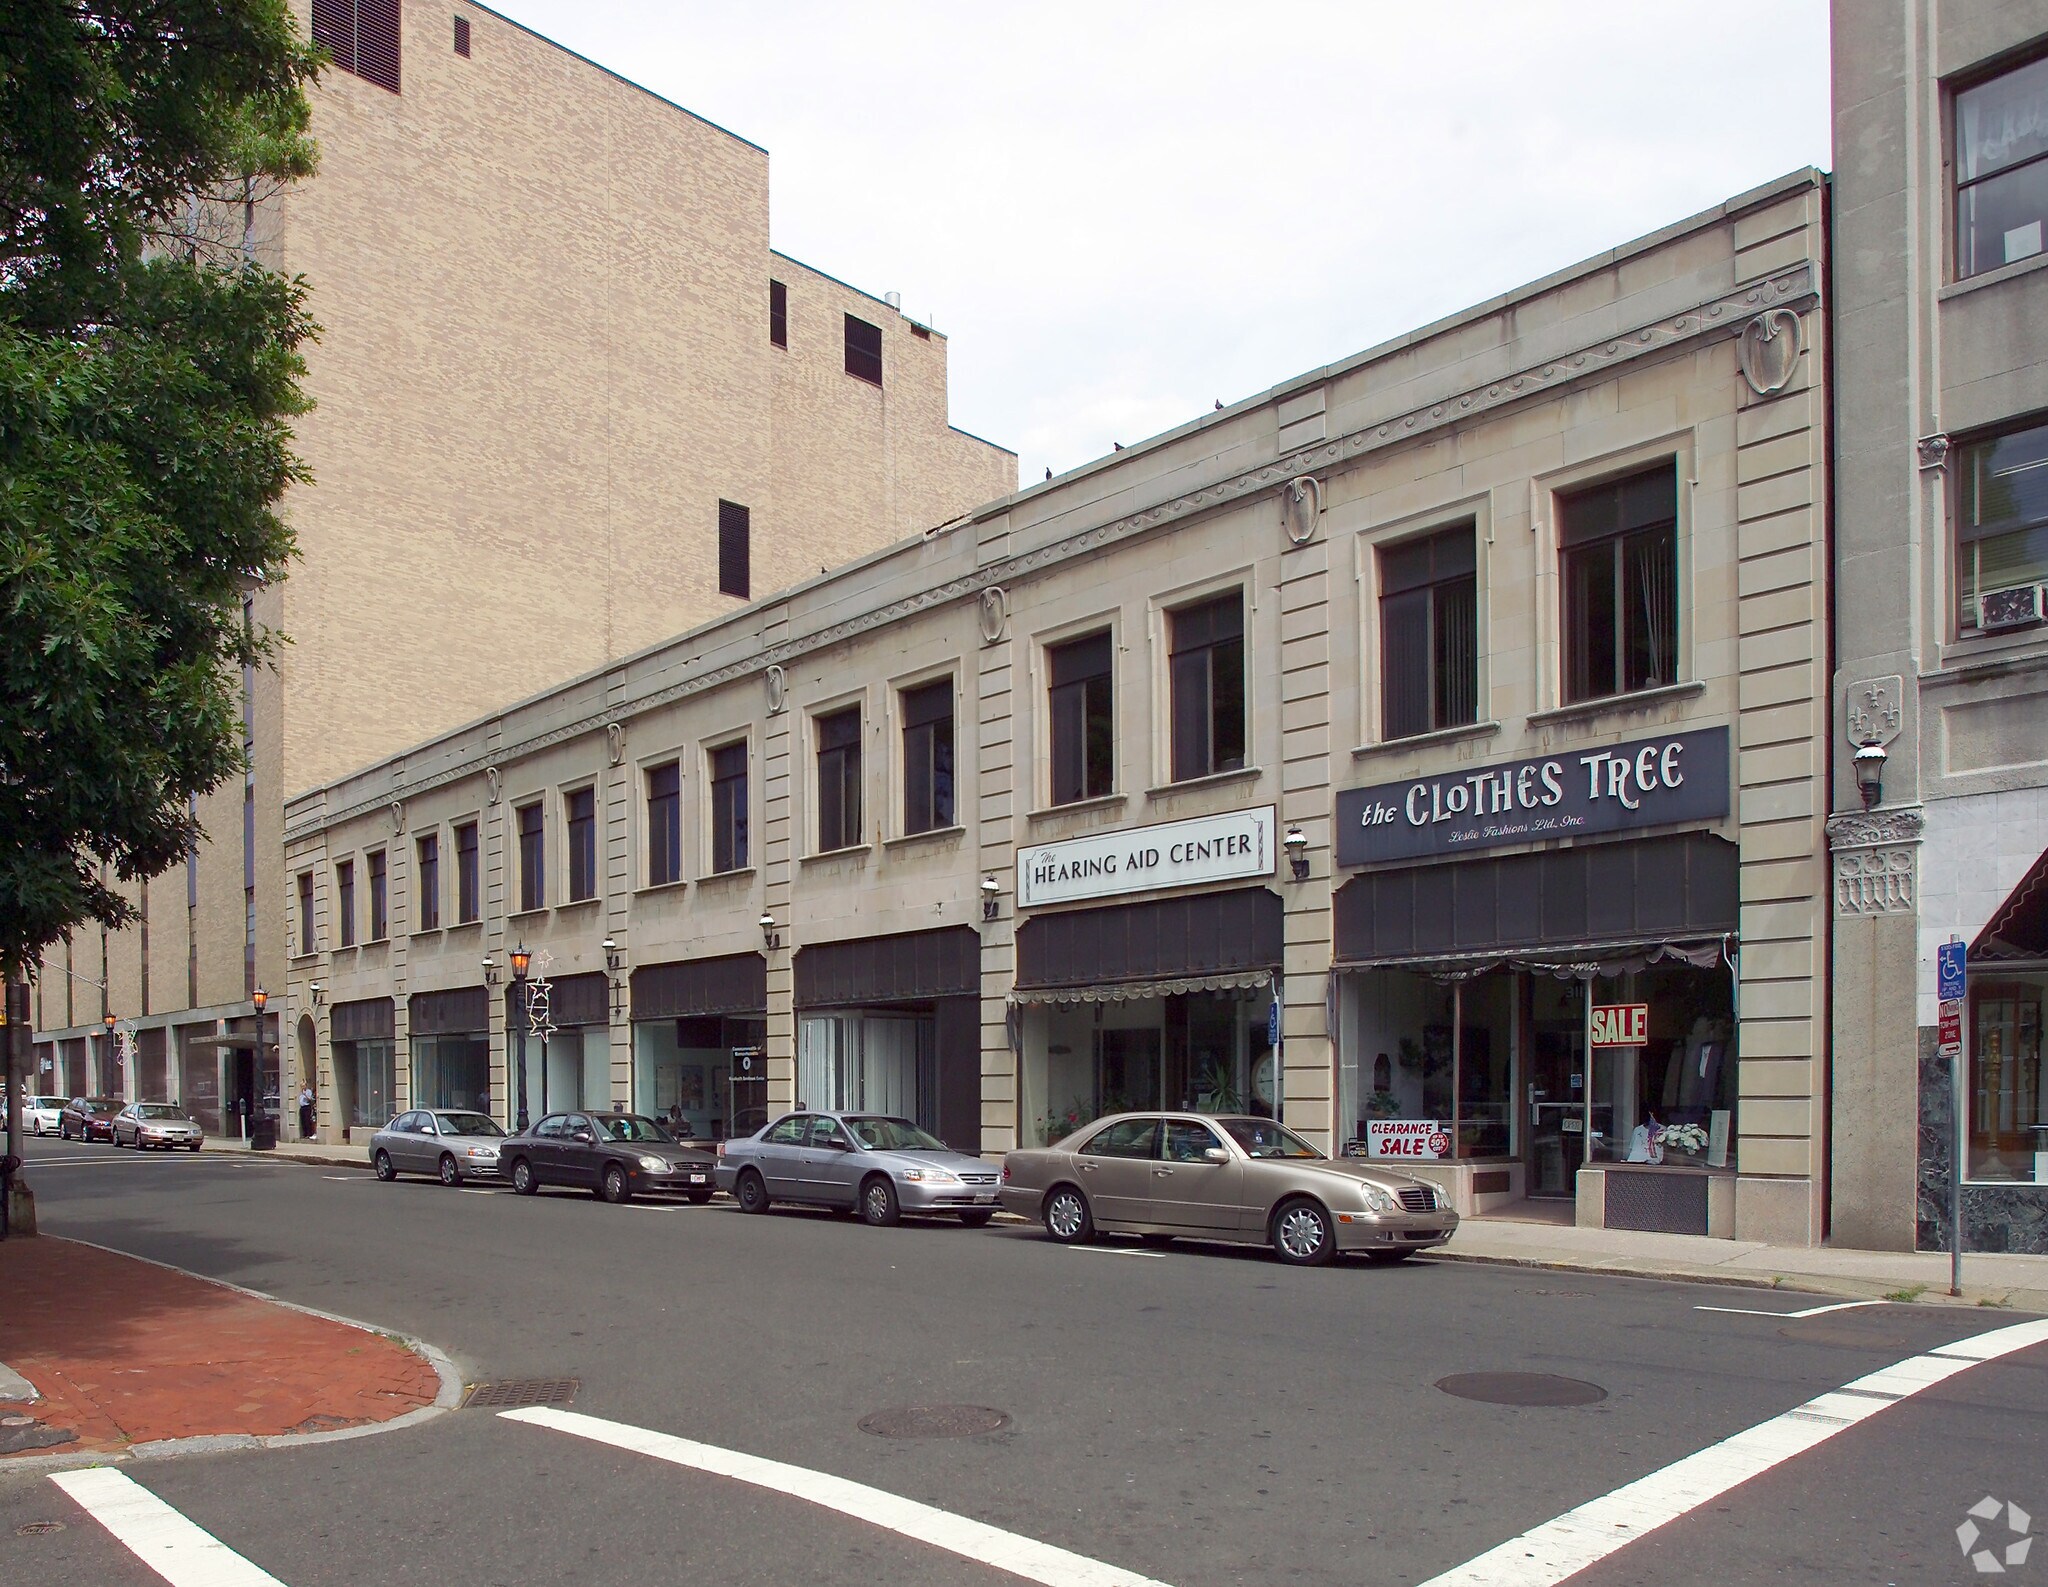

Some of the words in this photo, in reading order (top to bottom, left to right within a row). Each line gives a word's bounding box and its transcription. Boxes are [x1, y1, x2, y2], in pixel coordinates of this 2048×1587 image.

[1361, 801, 1397, 826] the
[1580, 742, 1684, 810] TREE
[1448, 830, 1479, 843] Leslie
[1482, 824, 1528, 838] Fashions
[1035, 854, 1117, 884] HEARING
[1126, 848, 1160, 871] AID
[1170, 834, 1252, 863] CENTER
[1041, 851, 1056, 864] The
[1591, 1008, 1646, 1043] SALE
[1371, 1123, 1433, 1134] CLEARANCE
[1379, 1138, 1425, 1155] SALE
